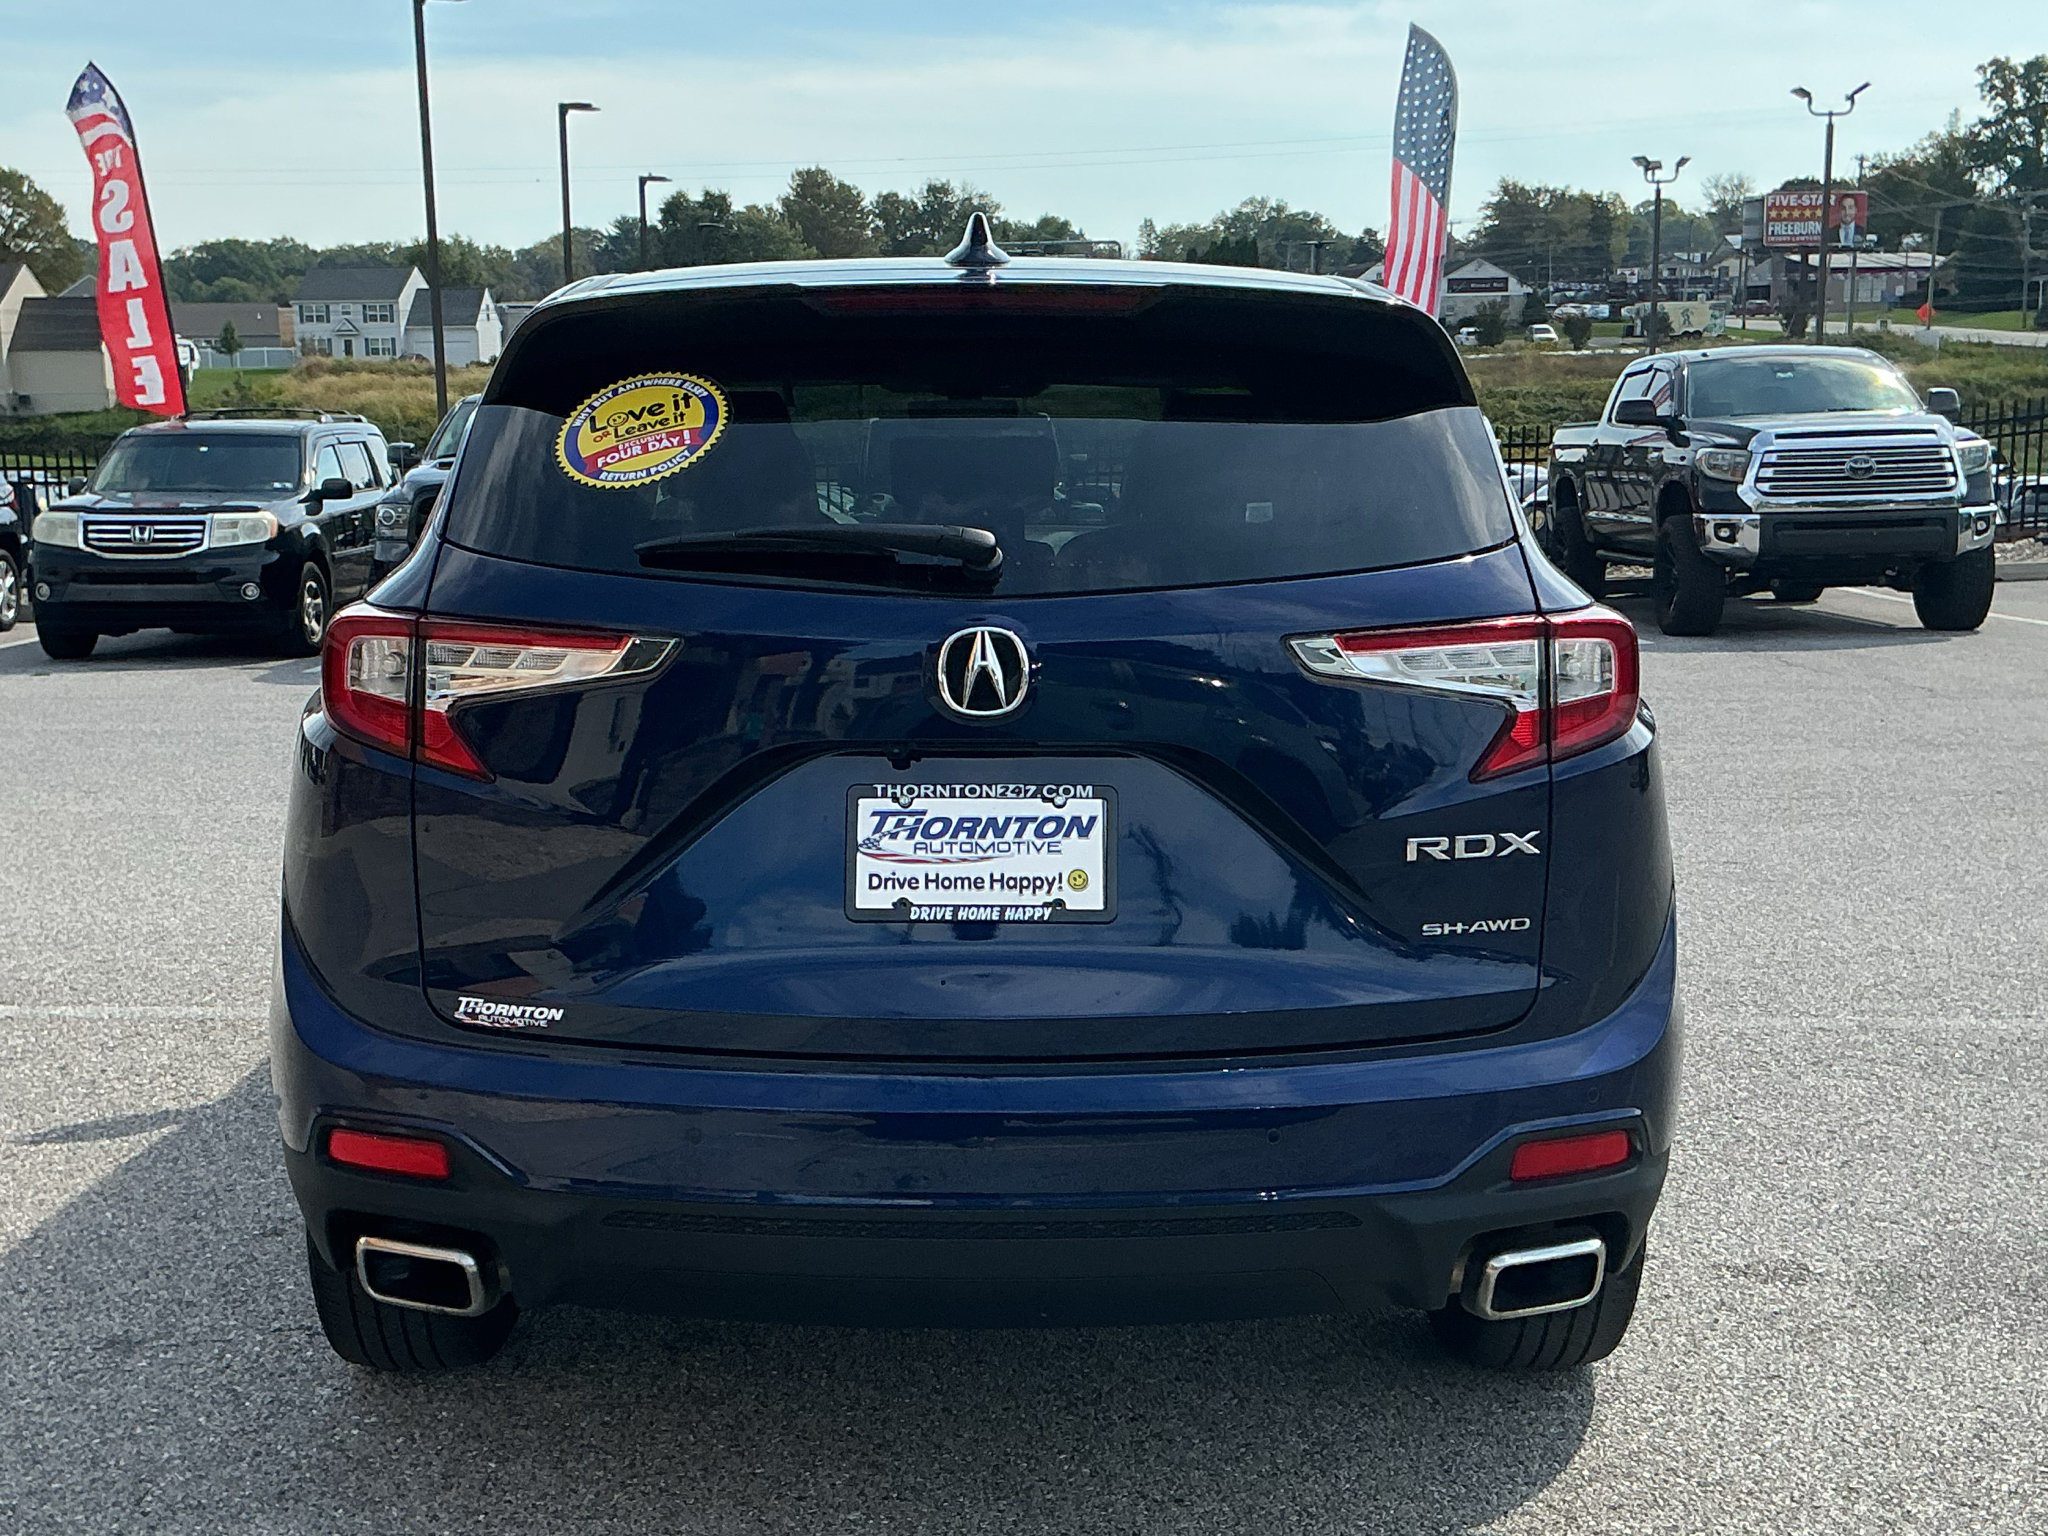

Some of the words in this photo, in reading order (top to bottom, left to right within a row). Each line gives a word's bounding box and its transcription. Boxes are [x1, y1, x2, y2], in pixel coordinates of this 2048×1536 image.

[1768, 221, 1822, 235] FREEBURN
[572, 407, 593, 428] WHY
[593, 392, 615, 408] BUY
[617, 377, 683, 395] ANYWHERE
[682, 381, 710, 398] ELSE?
[672, 392, 693, 412] it
[593, 430, 613, 444] OR
[613, 417, 671, 439] Leave
[673, 411, 687, 424] it
[618, 433, 667, 451] EXCLUSIVE
[597, 445, 643, 469] FOUR
[599, 469, 648, 482] RETURN
[650, 451, 691, 476] POLICY
[873, 784, 1094, 798] THORNTON247.COM
[869, 809, 1098, 840] THORNTON
[913, 841, 1063, 855] AUTOMOTIVE
[1406, 830, 1541, 862] RDX
[868, 872, 920, 890] Drive
[924, 873, 985, 890] Home
[989, 872, 1063, 895] Happy!
[909, 907, 953, 921] DRIVE
[957, 907, 1001, 920] HOME
[1004, 907, 1053, 920] HAPPY
[457, 996, 565, 1021] THORNTON
[478, 1014, 549, 1028] AUTOMOTIVE
